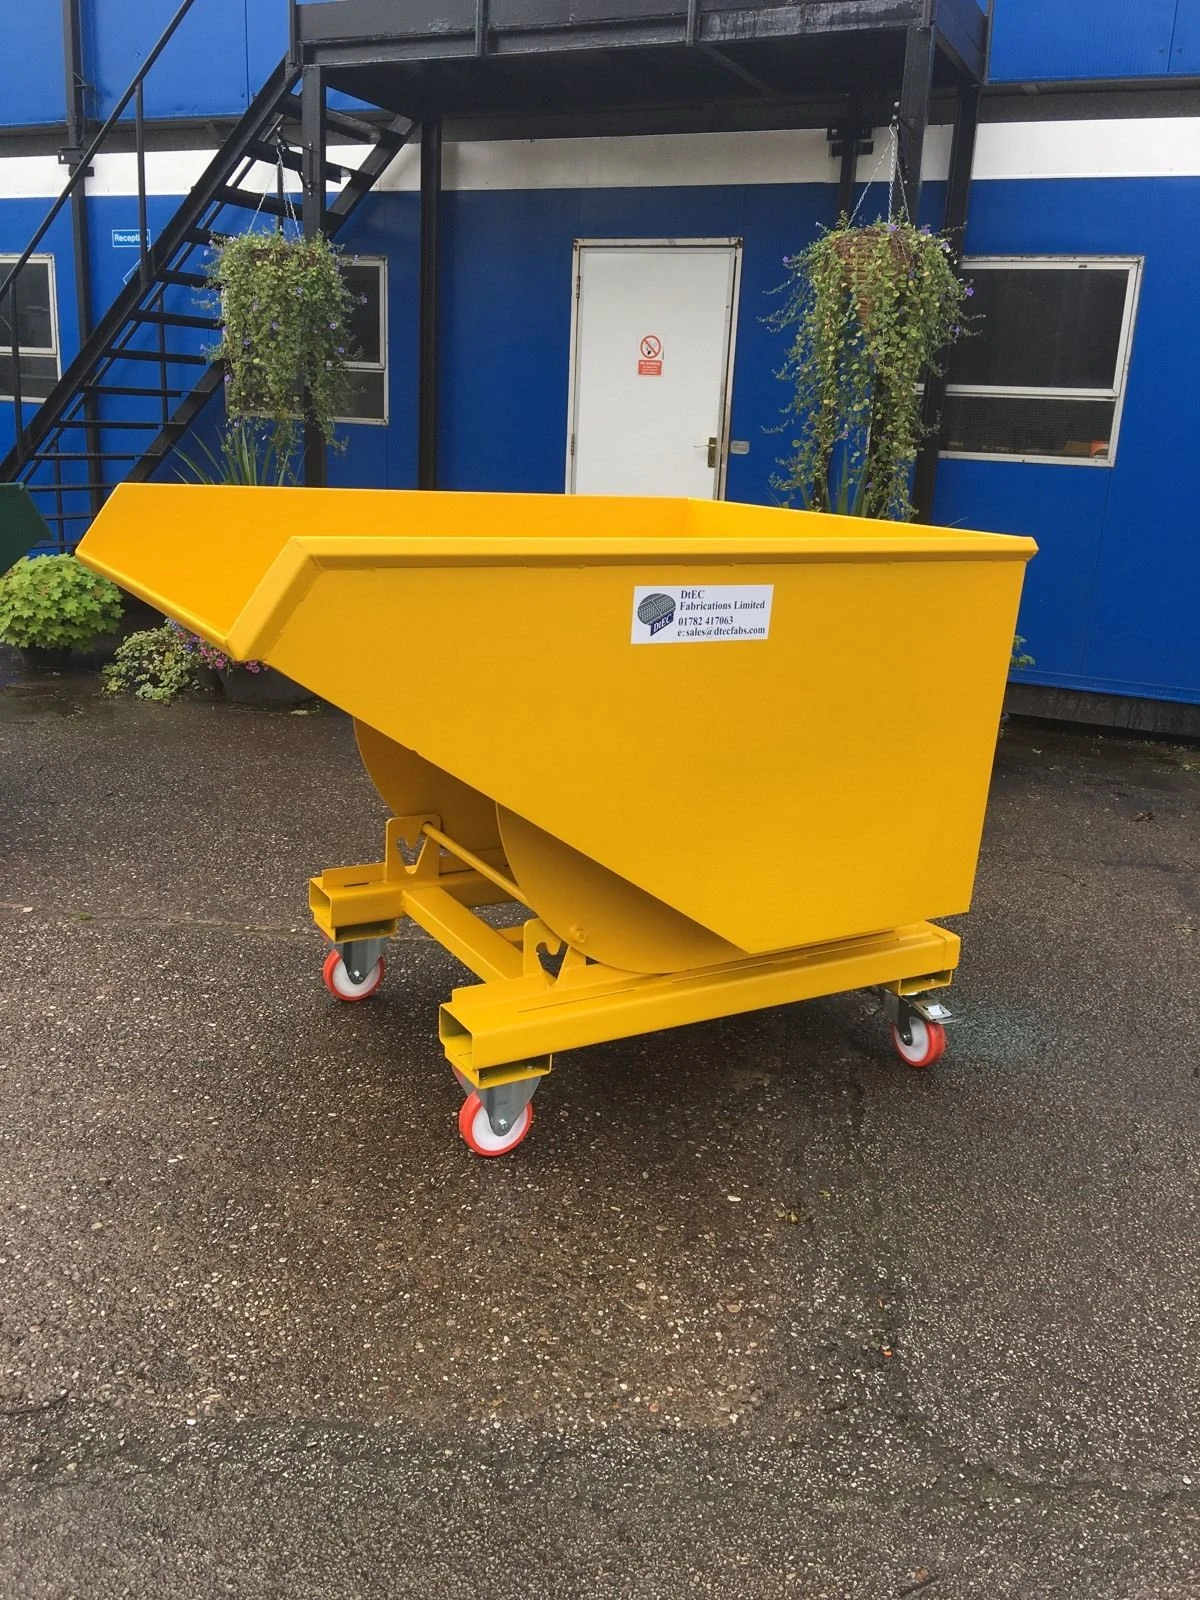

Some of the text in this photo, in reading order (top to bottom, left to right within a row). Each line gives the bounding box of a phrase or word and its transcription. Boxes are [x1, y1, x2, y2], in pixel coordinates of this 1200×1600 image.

[114, 233, 149, 243] Recepti
[681, 590, 705, 599] DtEC
[680, 600, 765, 611] Fabrications Limited
[653, 614, 673, 633] DtEC
[678, 616, 734, 626] 01782 417063
